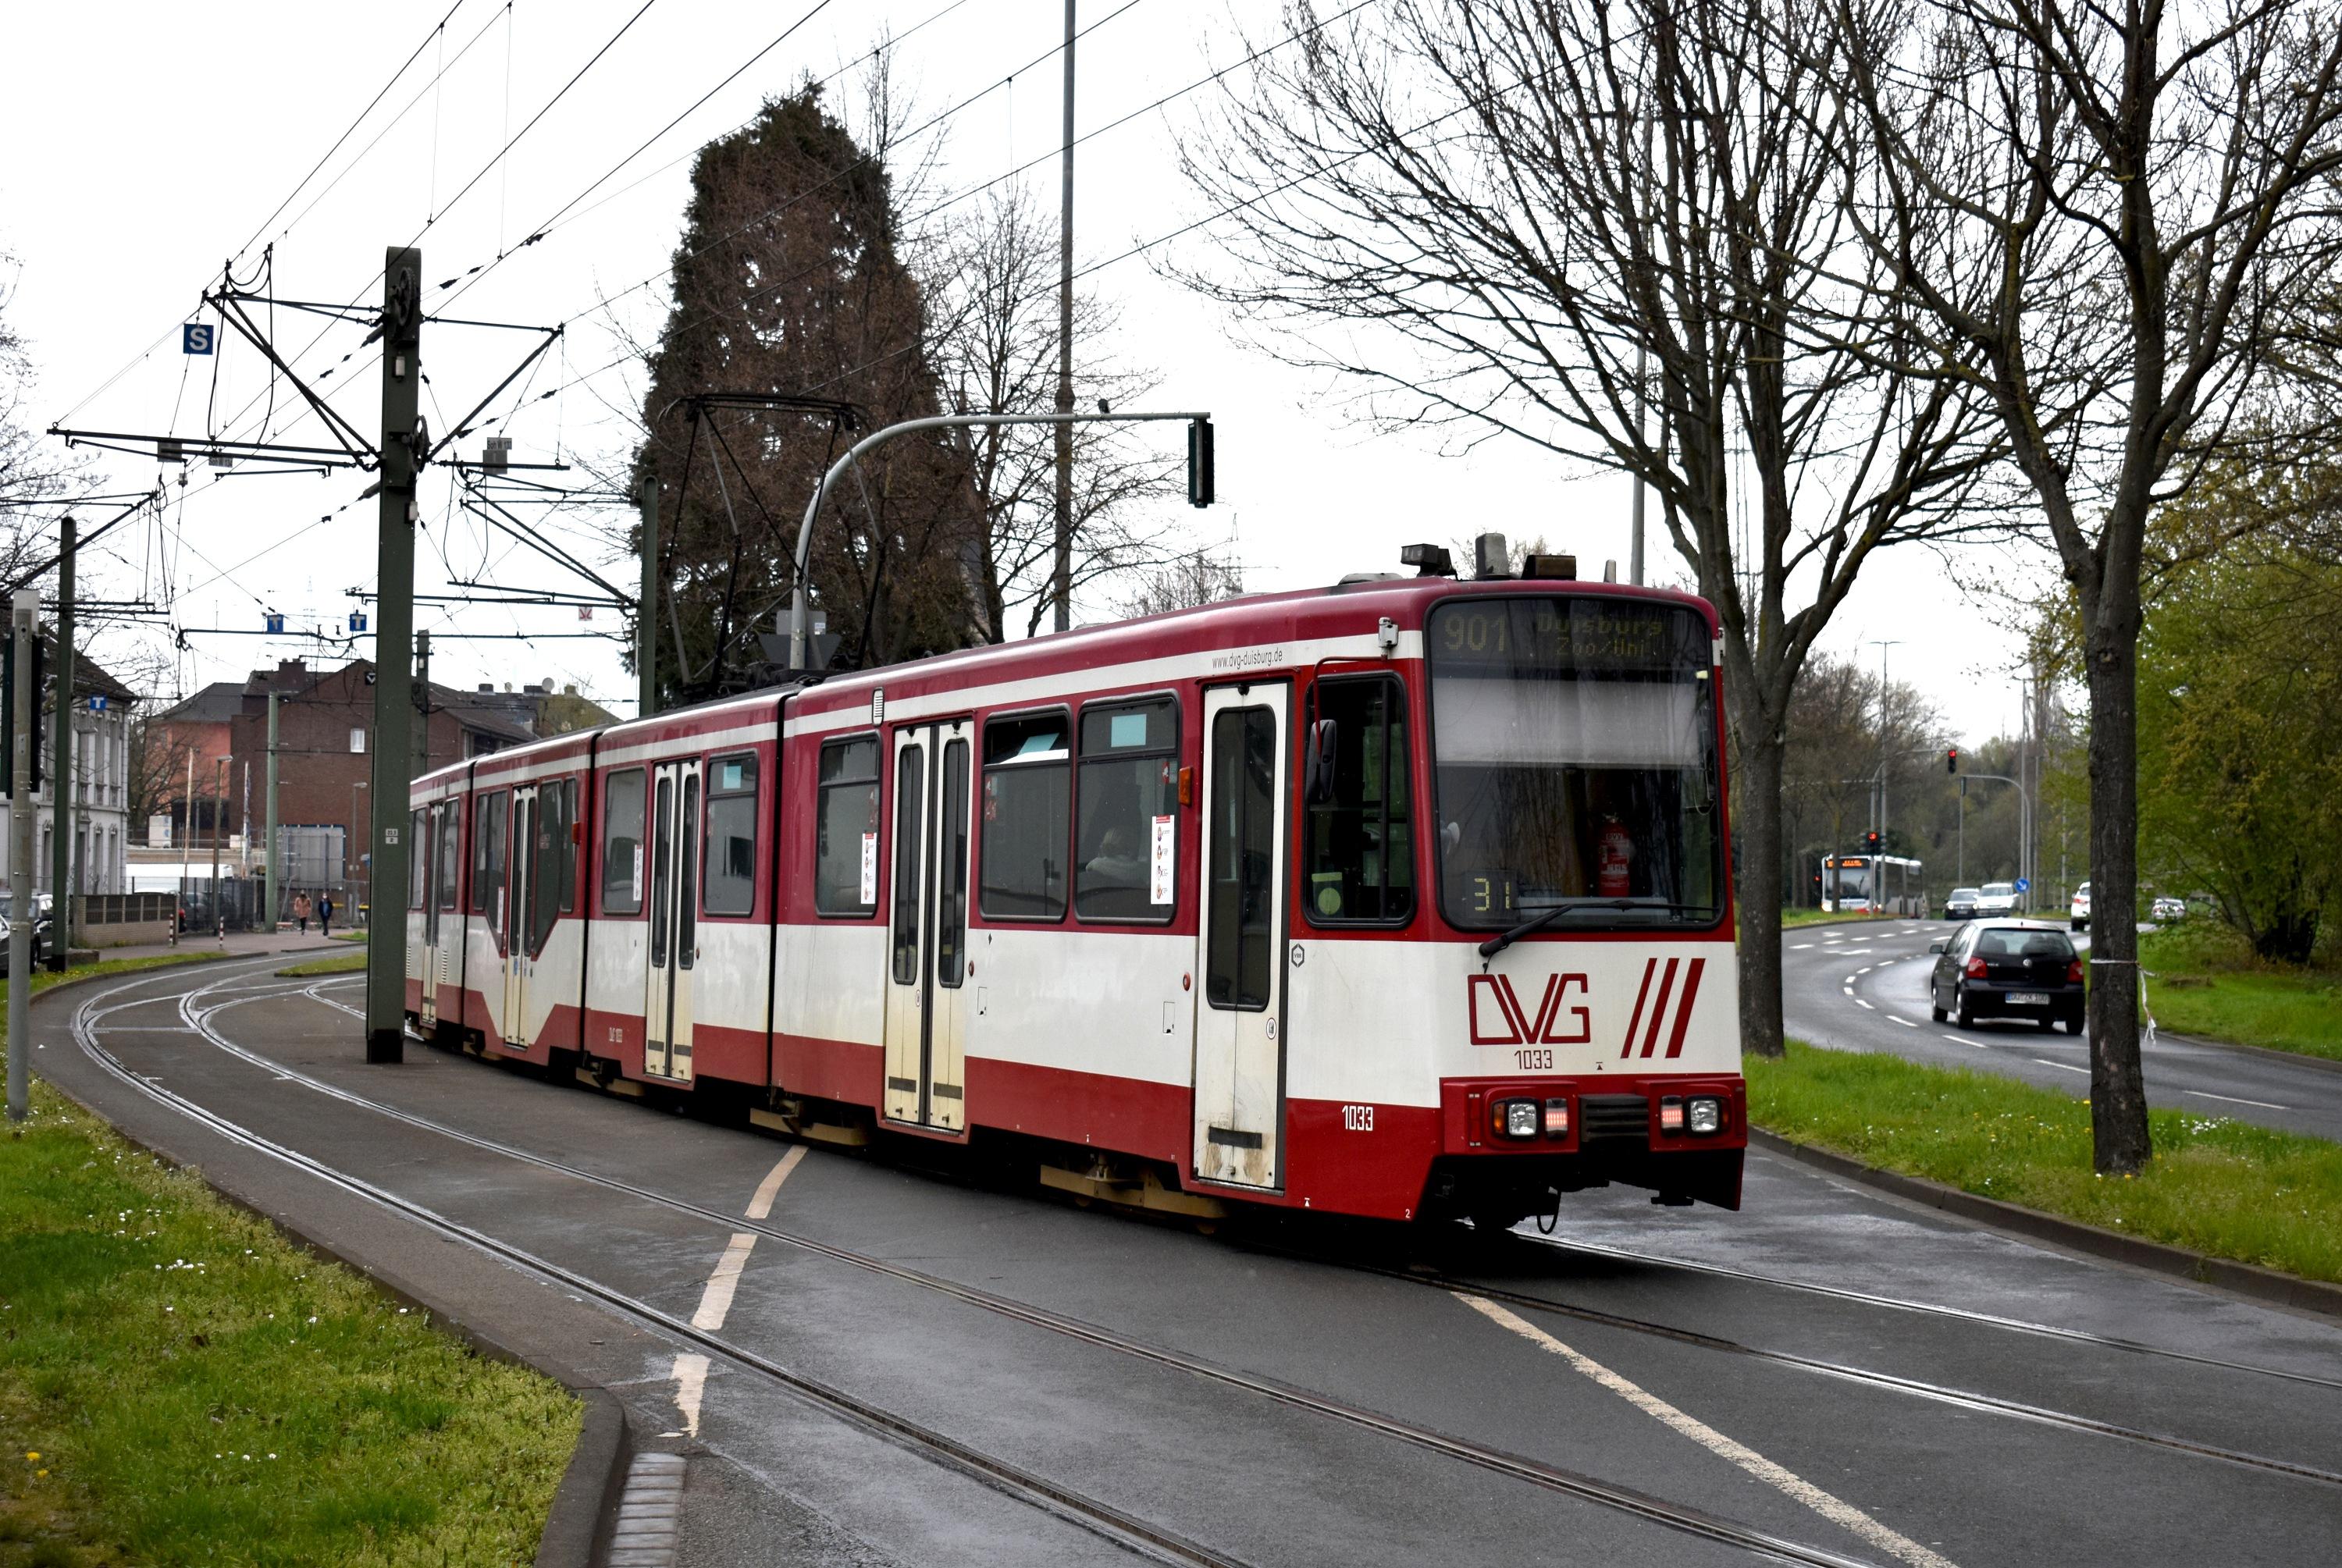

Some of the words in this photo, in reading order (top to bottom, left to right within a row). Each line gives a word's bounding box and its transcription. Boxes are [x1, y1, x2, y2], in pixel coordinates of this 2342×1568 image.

[189, 327, 208, 351] S
[269, 617, 282, 630] T
[351, 616, 365, 630] T
[1444, 613, 1506, 652] 901
[1212, 647, 1283, 670] www.dvg-duisburg.de
[92, 697, 105, 709] T
[1474, 878, 1510, 911] 31
[1467, 972, 1591, 1046] DVG
[1514, 1049, 1553, 1069] 1033
[1341, 1104, 1374, 1132] 1033
[1405, 1209, 1411, 1218] 2
